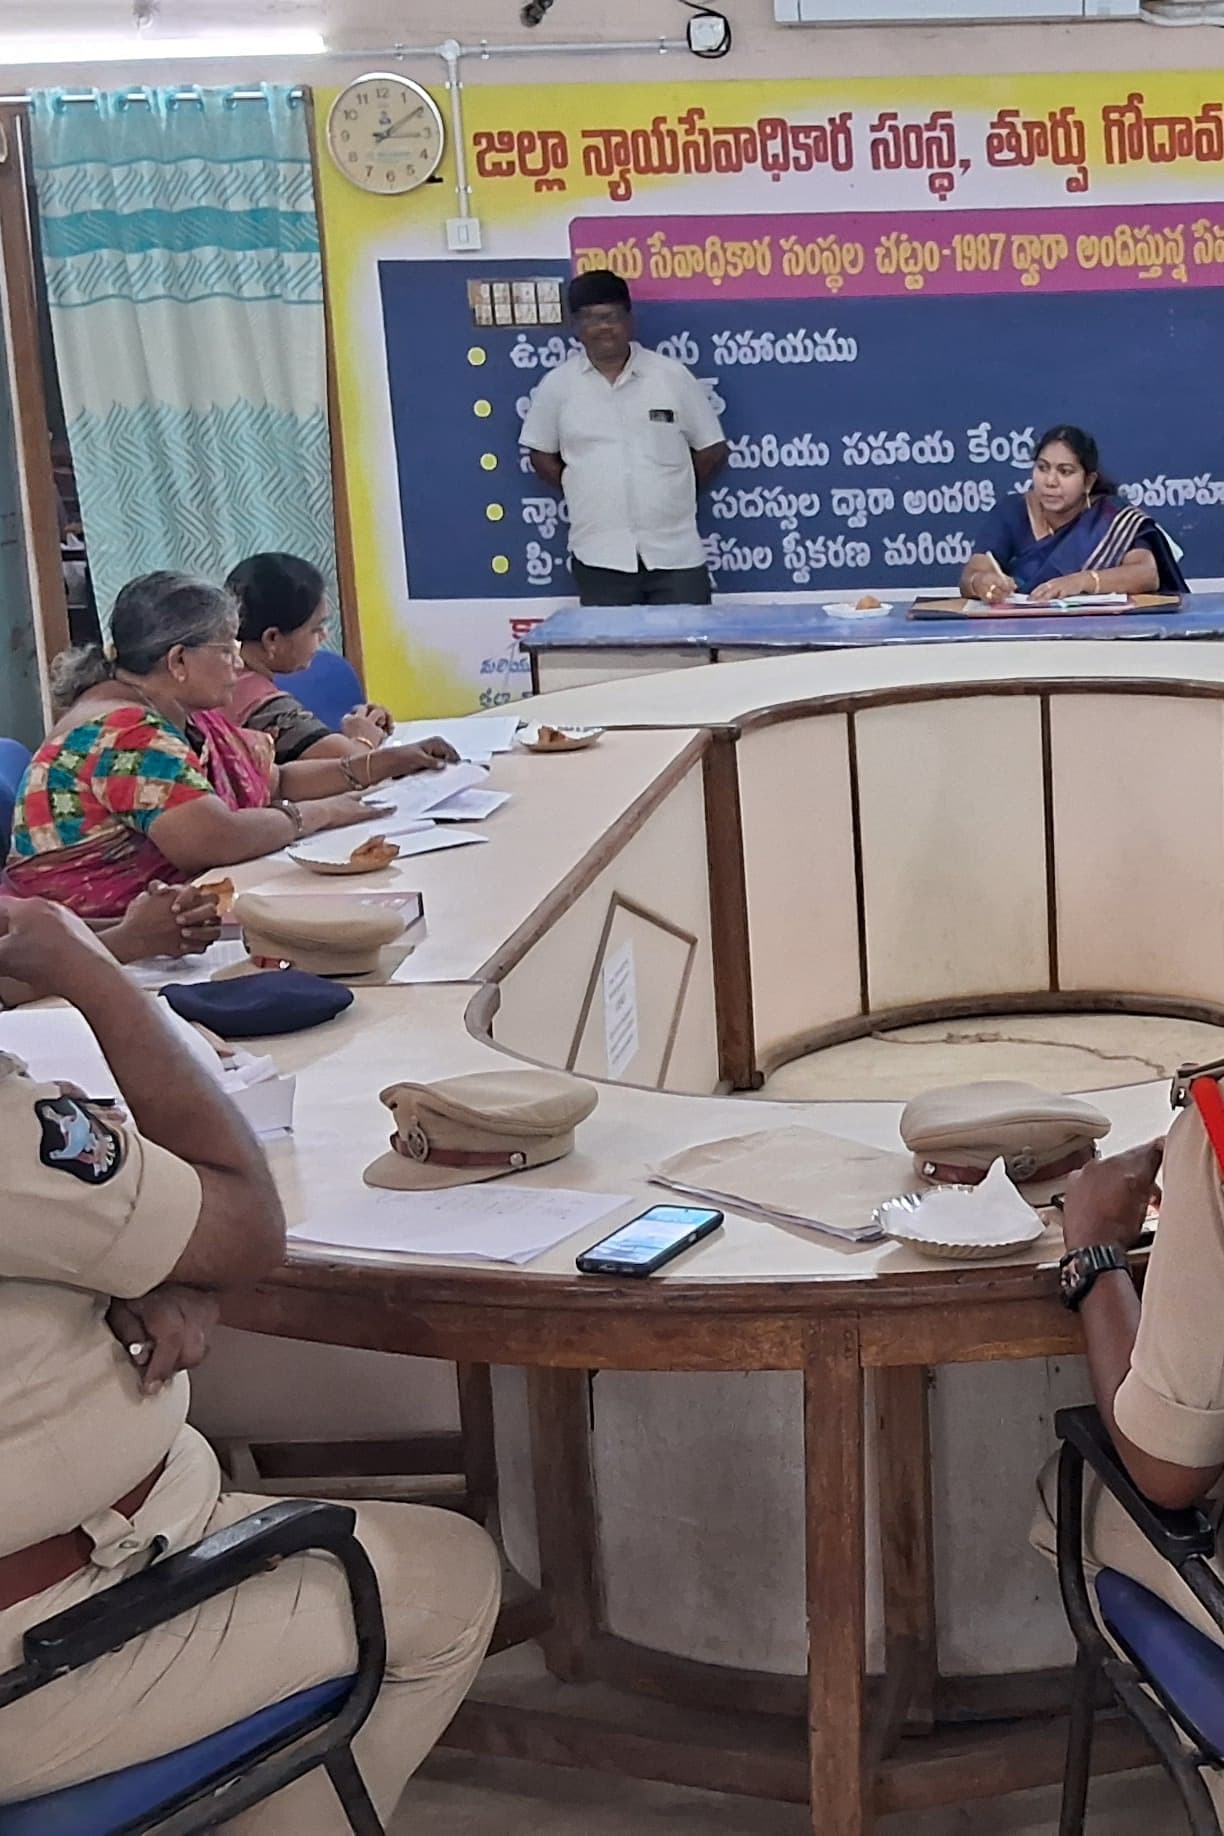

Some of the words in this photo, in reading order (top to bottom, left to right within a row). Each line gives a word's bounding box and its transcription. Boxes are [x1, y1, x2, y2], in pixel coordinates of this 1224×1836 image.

[356, 93, 368, 105] 11
[376, 88, 389, 99] 12
[343, 109, 358, 121] 10
[473, 130, 569, 193] జిల్లా
[581, 107, 853, 202] న్యాయసేవాధికార
[986, 106, 1089, 193] తూర్పు
[646, 231, 773, 286] సేవాధికార
[779, 234, 865, 293] సంస్థల
[1010, 233, 1068, 287] ద్వారా
[1077, 224, 1188, 283] అందిస్తున్న
[711, 327, 859, 366] సహాయము
[726, 432, 829, 469] మరియు
[841, 429, 955, 466] సహాయ
[710, 485, 821, 530] సదస్సుల
[831, 487, 895, 528] ద్వారా
[883, 530, 974, 567] మరియ
